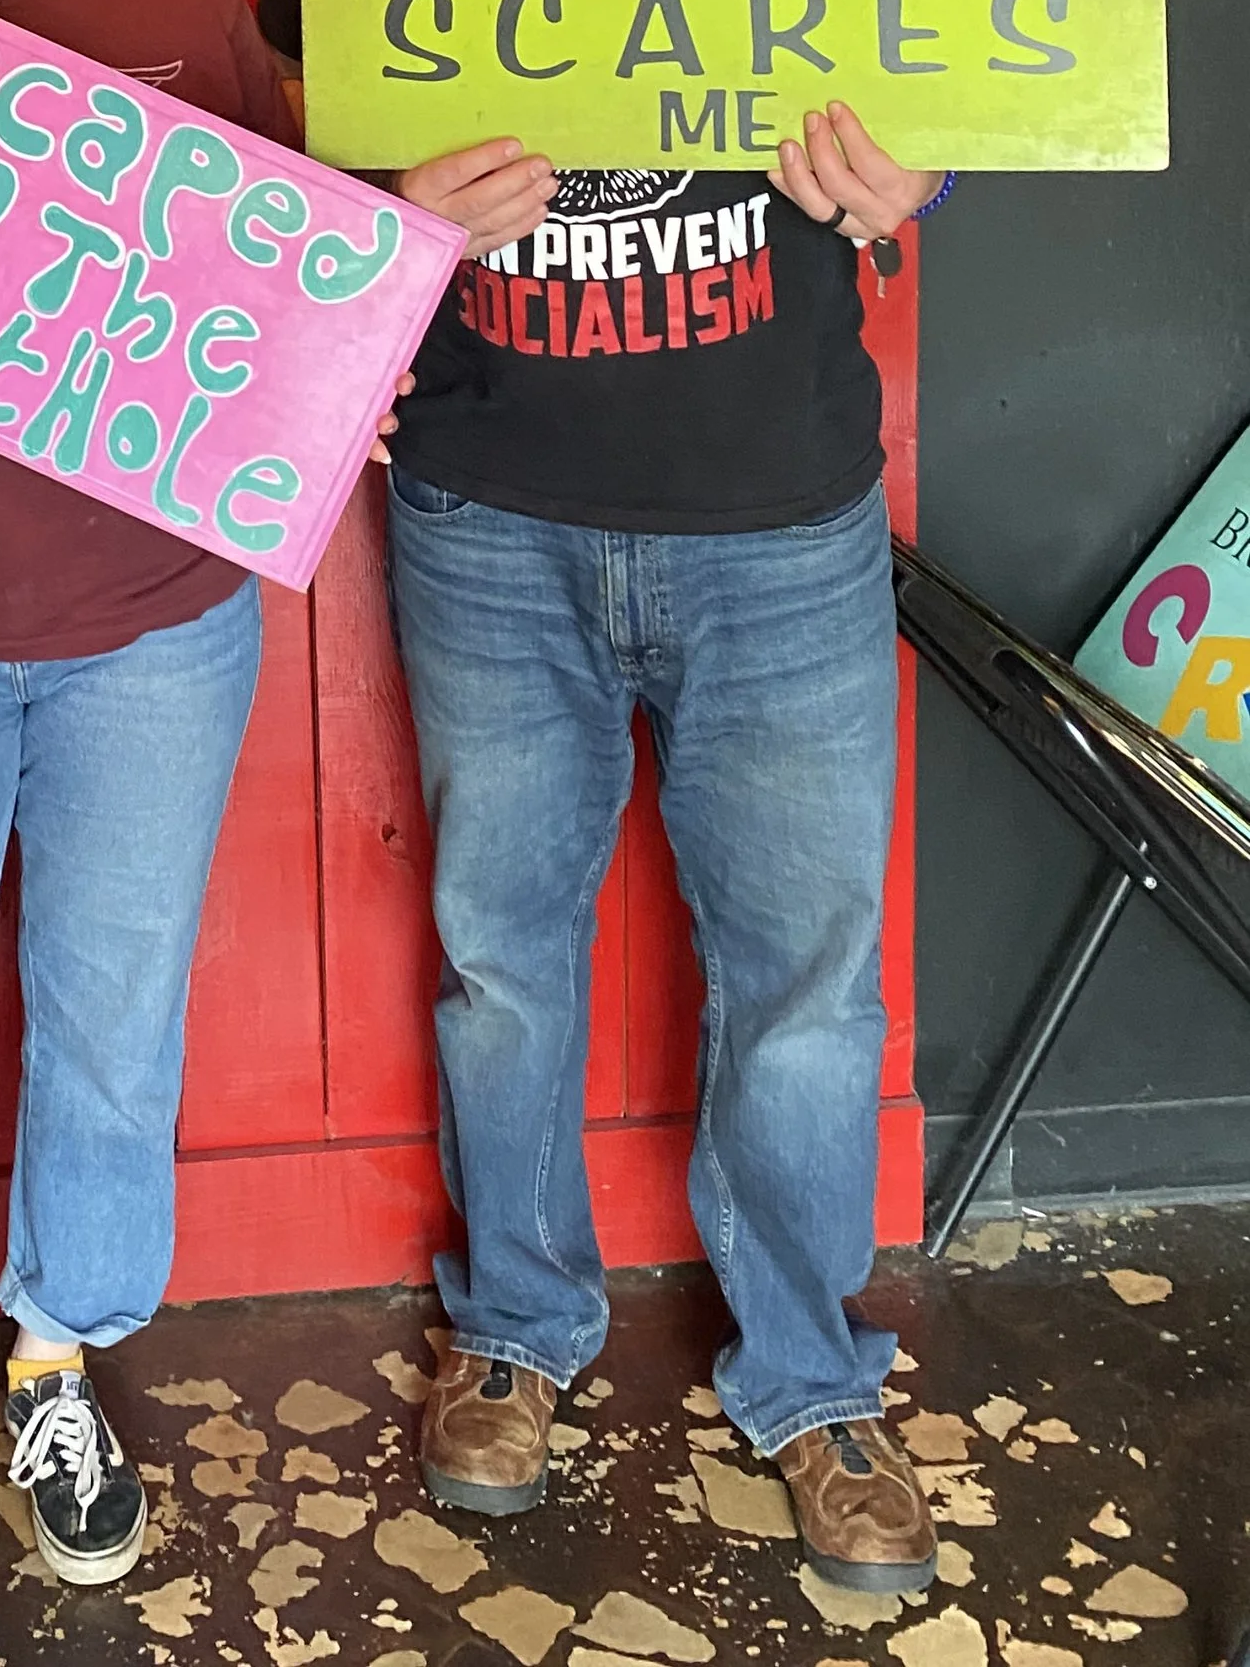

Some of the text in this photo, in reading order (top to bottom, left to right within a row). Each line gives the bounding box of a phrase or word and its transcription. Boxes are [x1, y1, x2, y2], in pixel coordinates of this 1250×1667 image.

[659, 89, 780, 153] ME
[532, 192, 771, 281] PREVENT
[24, 202, 261, 395] The
[457, 246, 775, 358] SOCIALISM
[1123, 564, 1250, 742] CR
